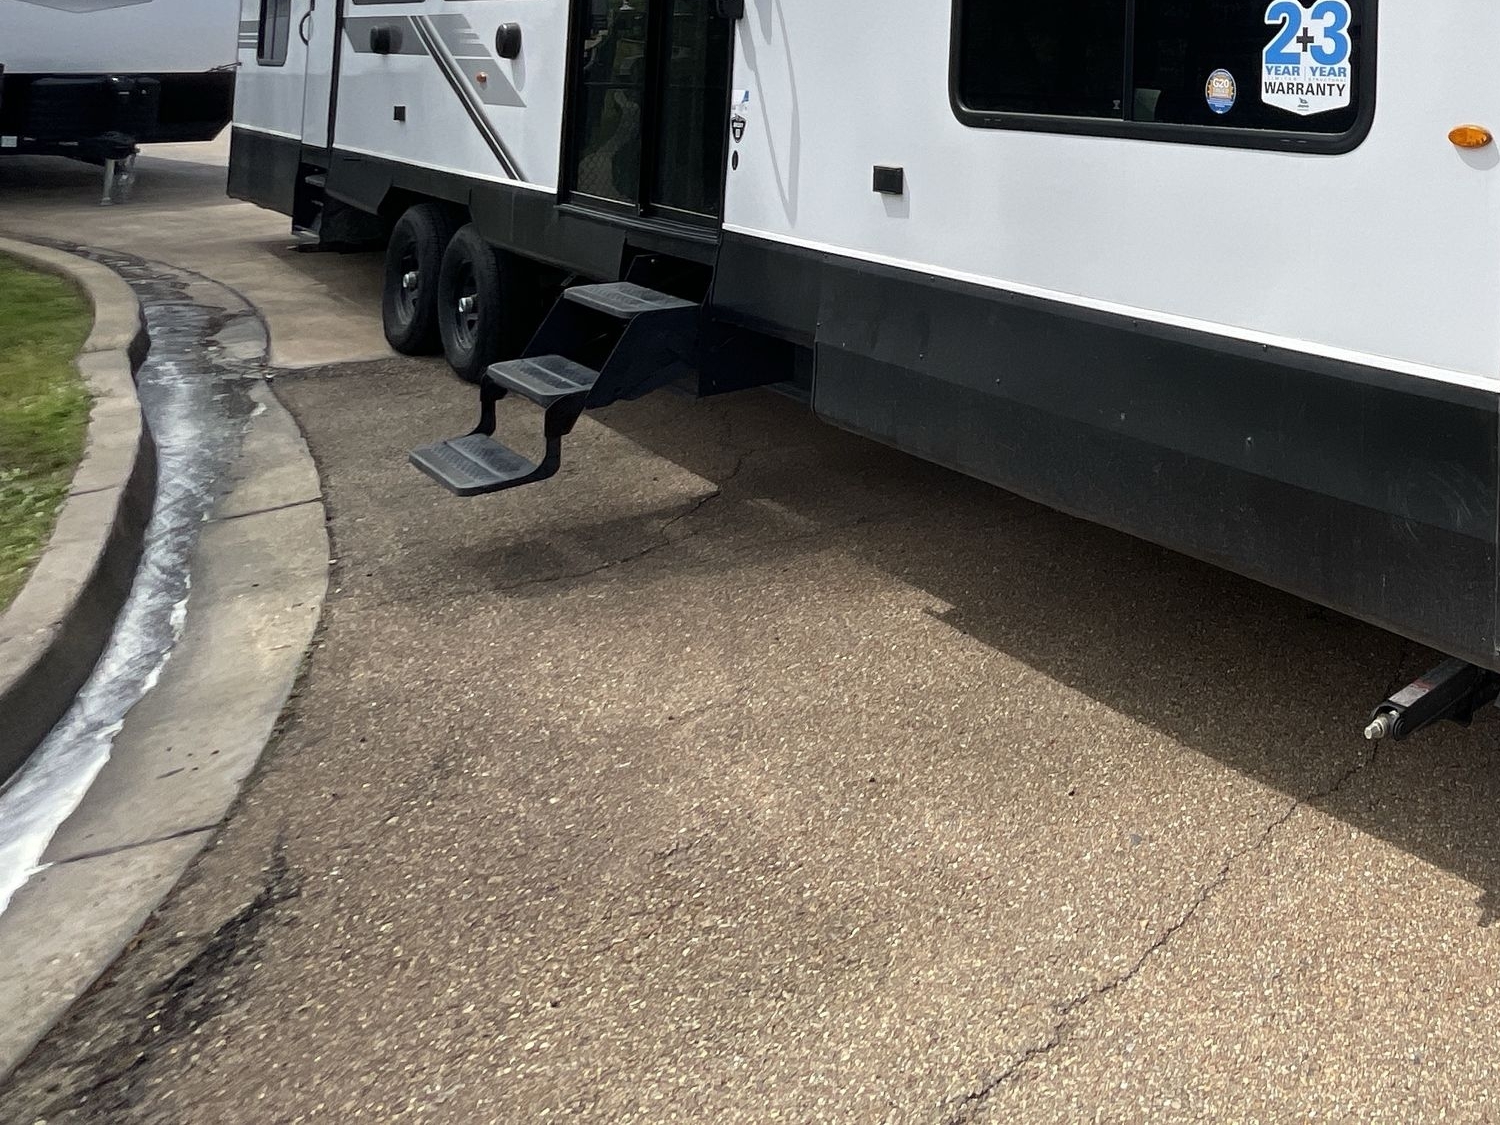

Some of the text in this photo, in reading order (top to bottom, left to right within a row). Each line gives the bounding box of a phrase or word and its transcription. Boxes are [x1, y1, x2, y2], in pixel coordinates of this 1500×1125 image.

[1265, 65, 1347, 78] YEAR YEAR
[1264, 81, 1346, 97] WARRANTY
